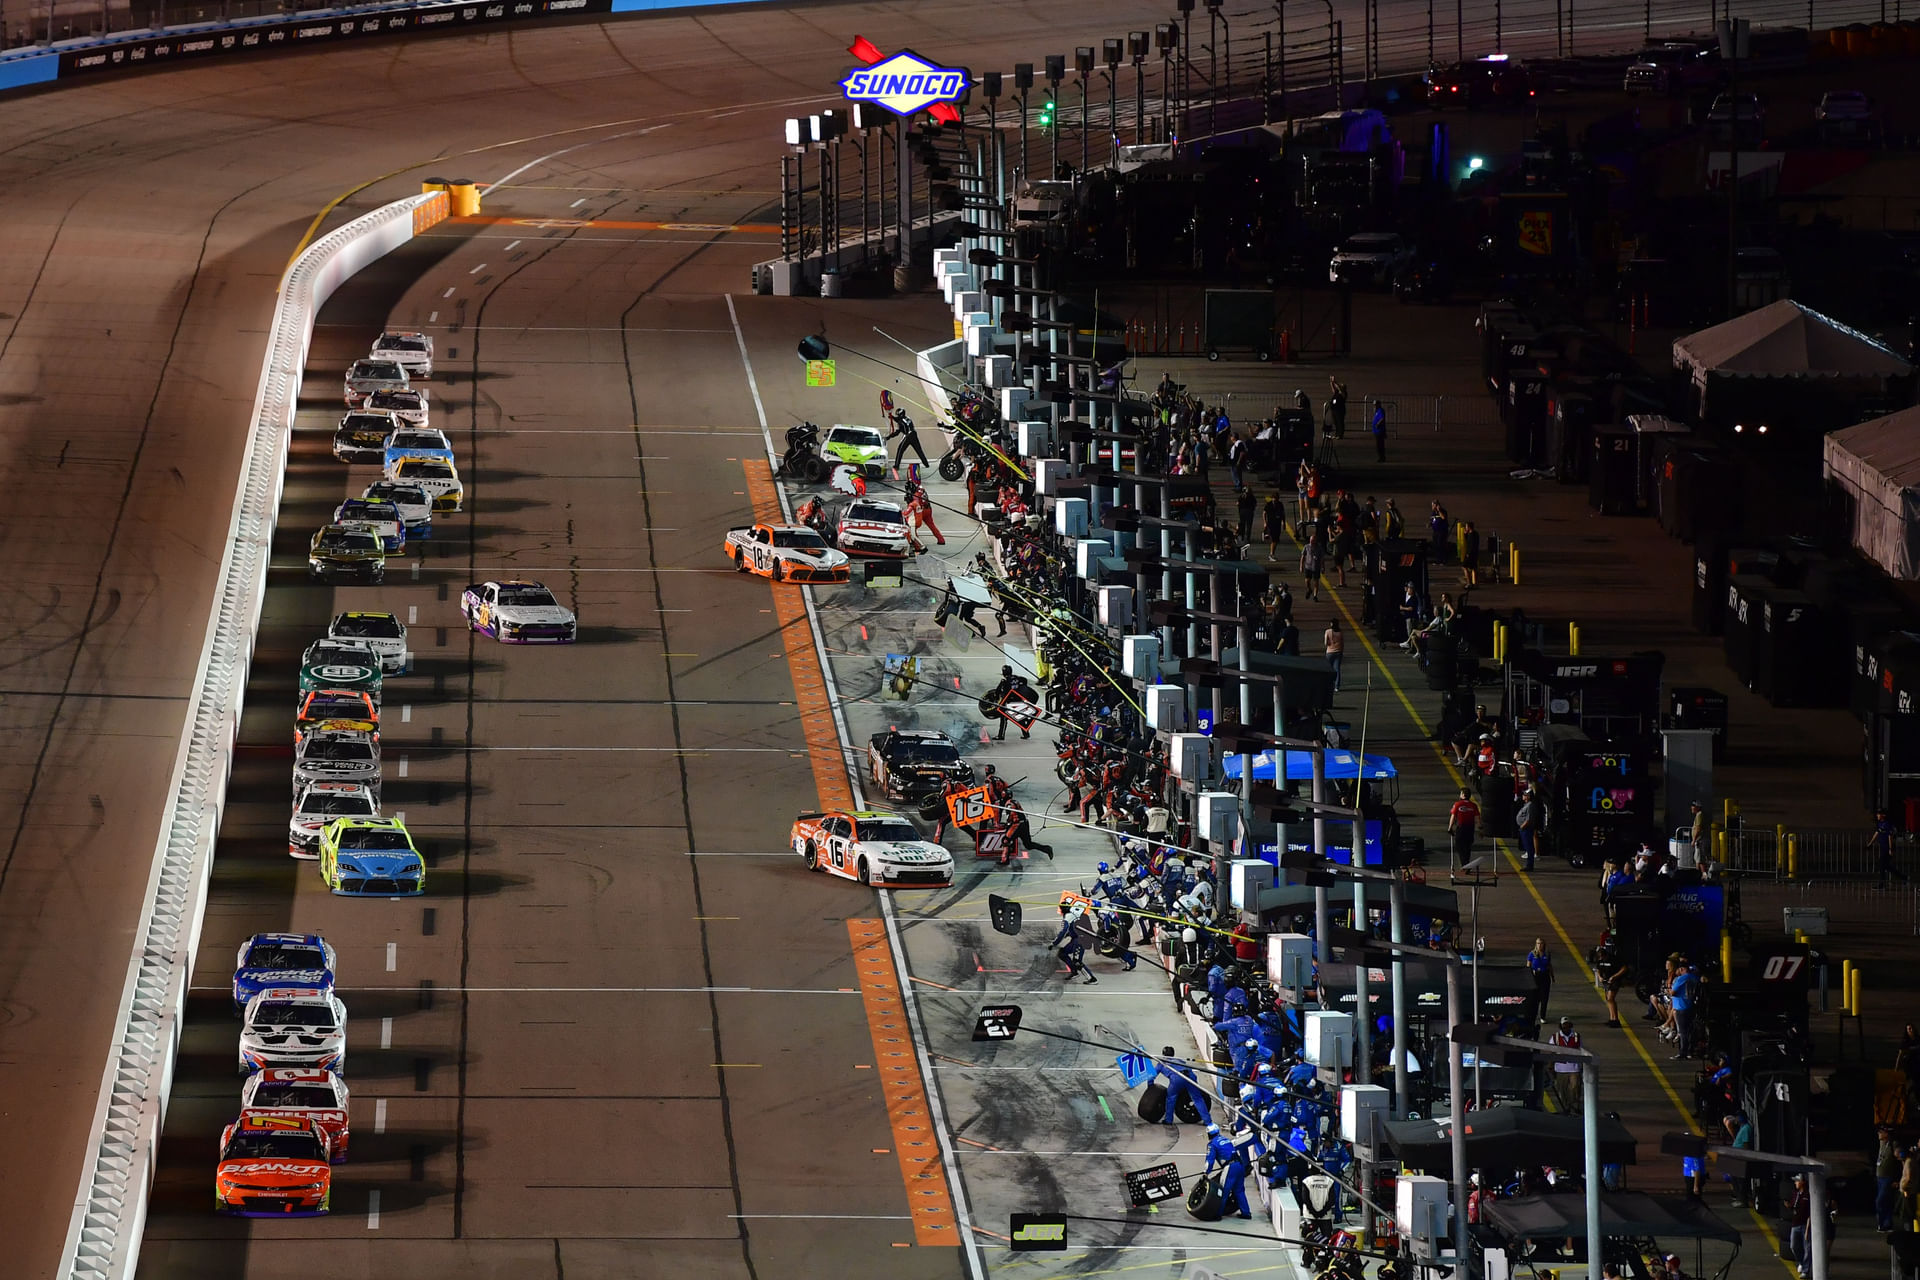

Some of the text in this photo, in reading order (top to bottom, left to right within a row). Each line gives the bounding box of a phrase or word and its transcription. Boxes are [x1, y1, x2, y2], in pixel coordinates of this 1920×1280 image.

[849, 73, 962, 96] SUNOCO
[1528, 231, 1545, 242] 25
[1510, 344, 1526, 356] 48
[1525, 382, 1541, 394] 24
[1613, 440, 1629, 451] 21
[753, 546, 764, 570] 18
[955, 792, 984, 822] 16
[829, 838, 844, 868] 16
[1667, 893, 1698, 902] AULIG
[241, 969, 325, 979] Hendrick
[1763, 955, 1802, 980] 07
[1121, 1046, 1146, 1079] 71
[245, 1111, 343, 1121] WHELEN
[219, 1163, 329, 1176] BRANDT
[1014, 1224, 1065, 1241] JGR
